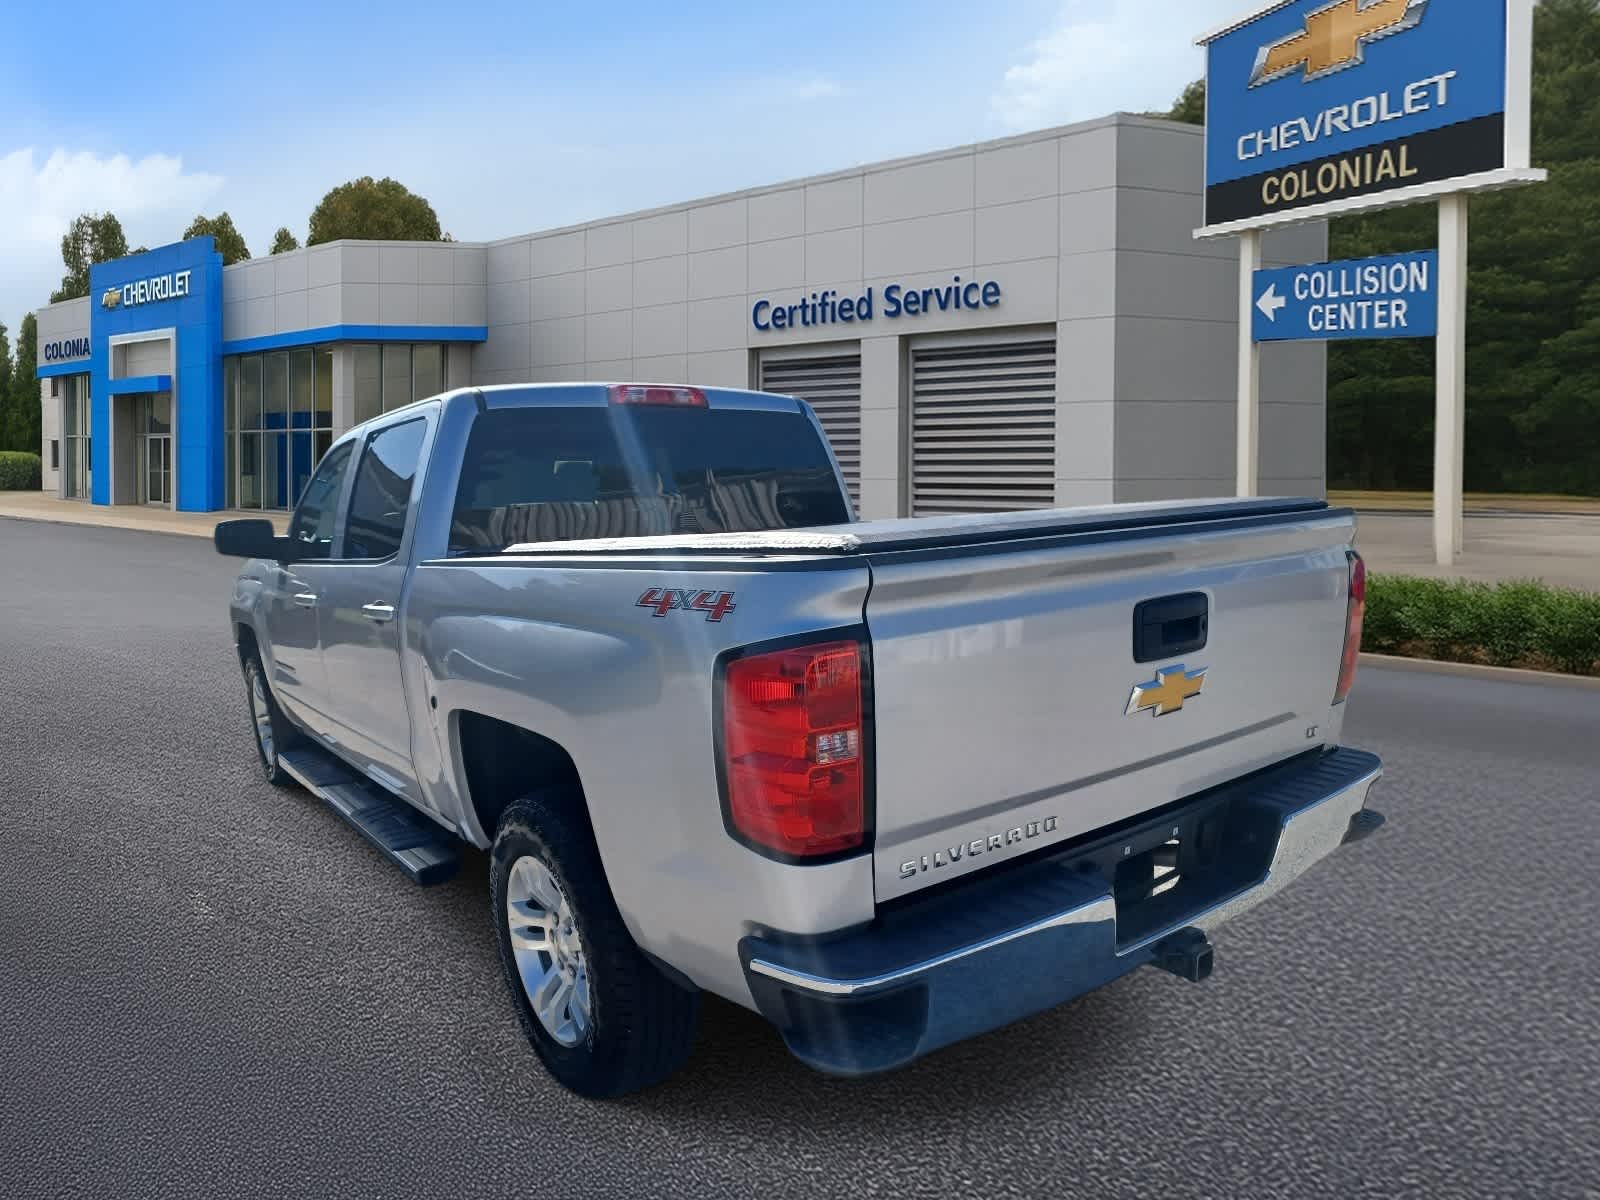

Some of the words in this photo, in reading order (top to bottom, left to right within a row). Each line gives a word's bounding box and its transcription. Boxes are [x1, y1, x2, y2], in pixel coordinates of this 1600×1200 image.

[1237, 70, 1457, 161] CHEVROLET
[1261, 145, 1418, 205] COLONIAL
[123, 270, 191, 307] CHEVROLET
[752, 287, 873, 331] Certified
[883, 276, 1001, 318] Service
[1294, 260, 1428, 300] COLLISION
[1308, 299, 1408, 331] CENTER
[44, 338, 91, 361] COLONIA
[900, 816, 1058, 879] SILVERADO
